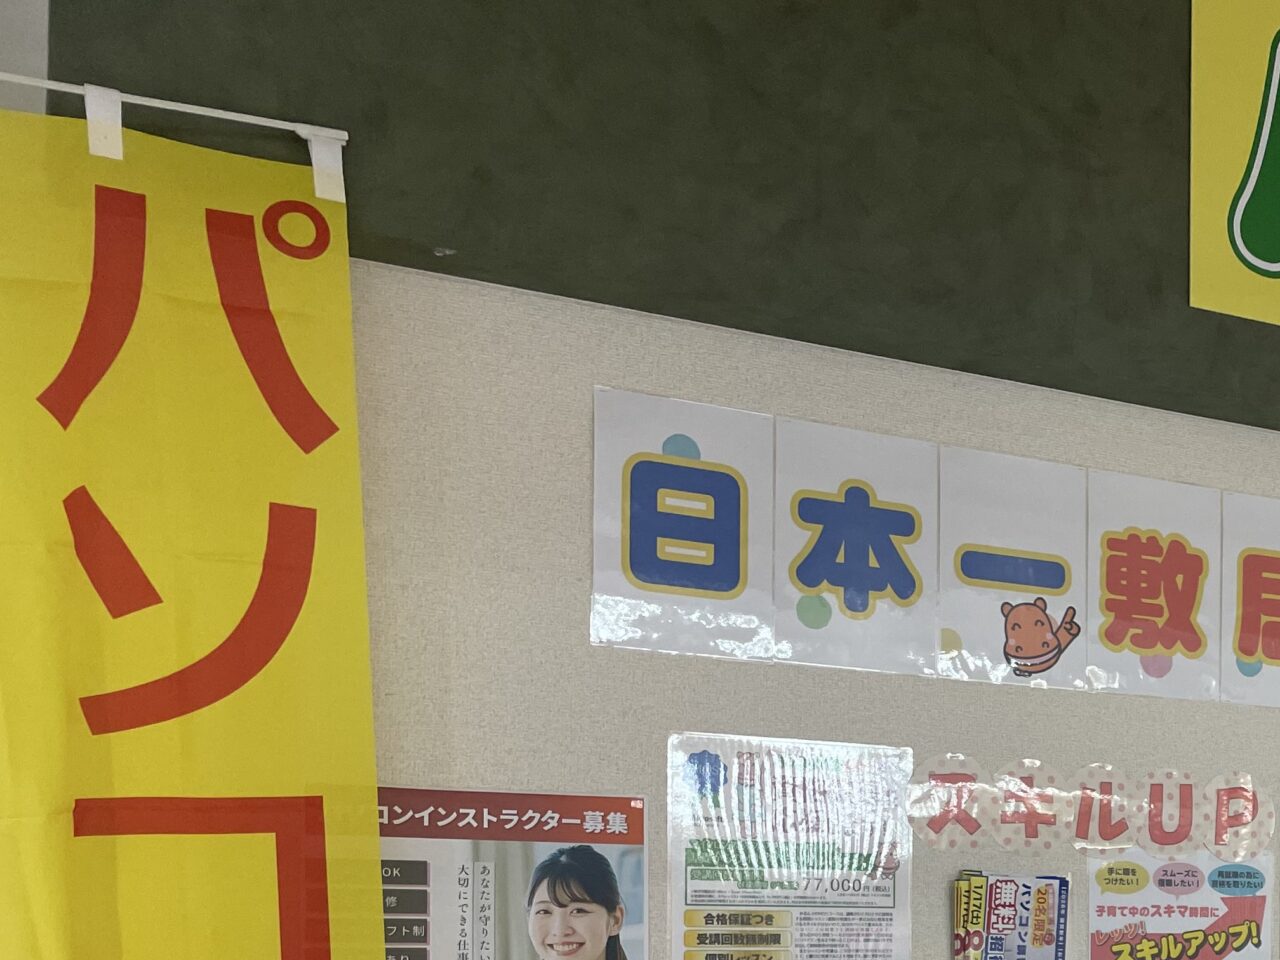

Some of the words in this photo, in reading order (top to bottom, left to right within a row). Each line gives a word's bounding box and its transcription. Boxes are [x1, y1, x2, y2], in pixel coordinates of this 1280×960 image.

[377, 804, 628, 834] コンインストラクター募集
[383, 867, 400, 877] OK
[1162, 869, 1198, 877] スムーズに
[386, 896, 398, 907] 修
[704, 913, 775, 926] 合格保証つき
[1033, 888, 1048, 946] 20名限定
